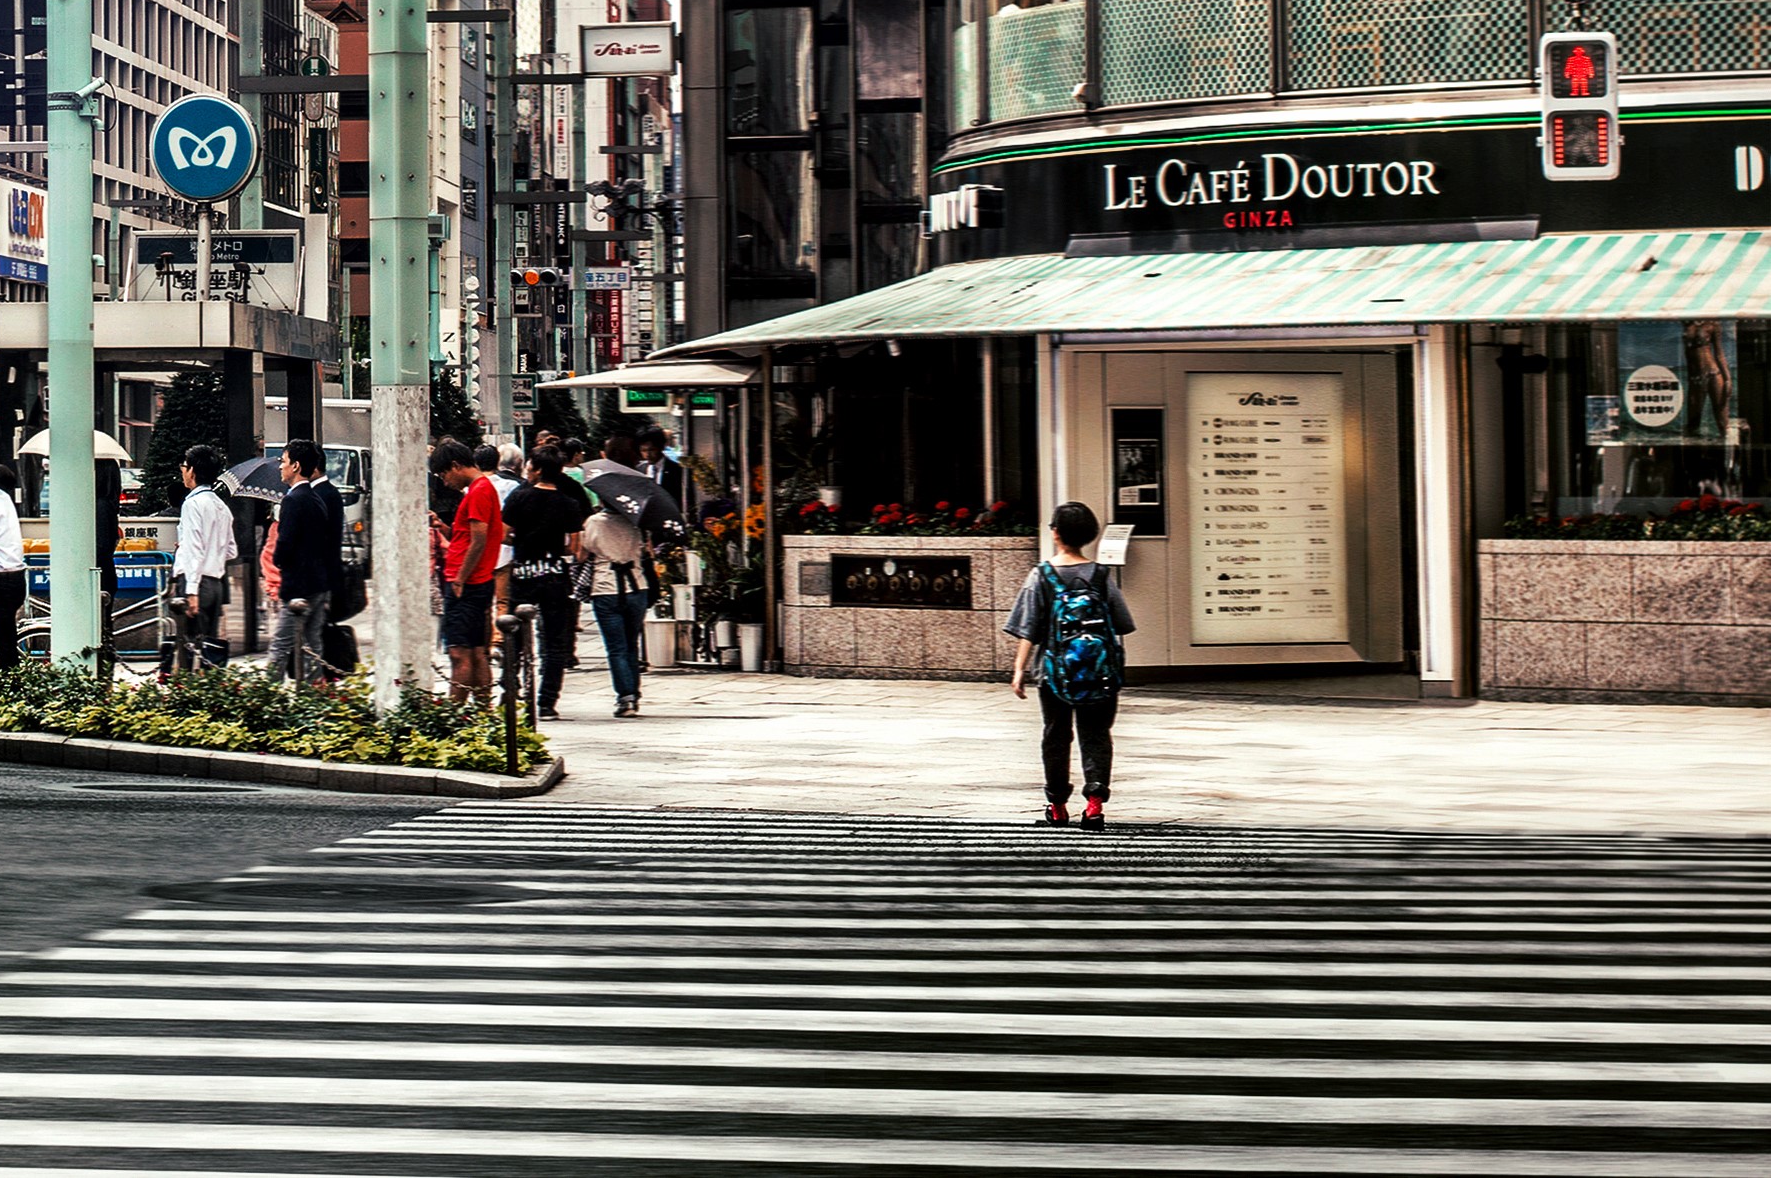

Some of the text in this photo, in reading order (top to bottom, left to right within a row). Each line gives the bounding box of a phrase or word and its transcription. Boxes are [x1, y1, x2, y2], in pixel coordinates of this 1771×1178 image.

[1104, 153, 1442, 211] LE CAFÉ DOUTOR
[1222, 209, 1295, 229] GINZA
[124, 527, 159, 539] 銀座駅
